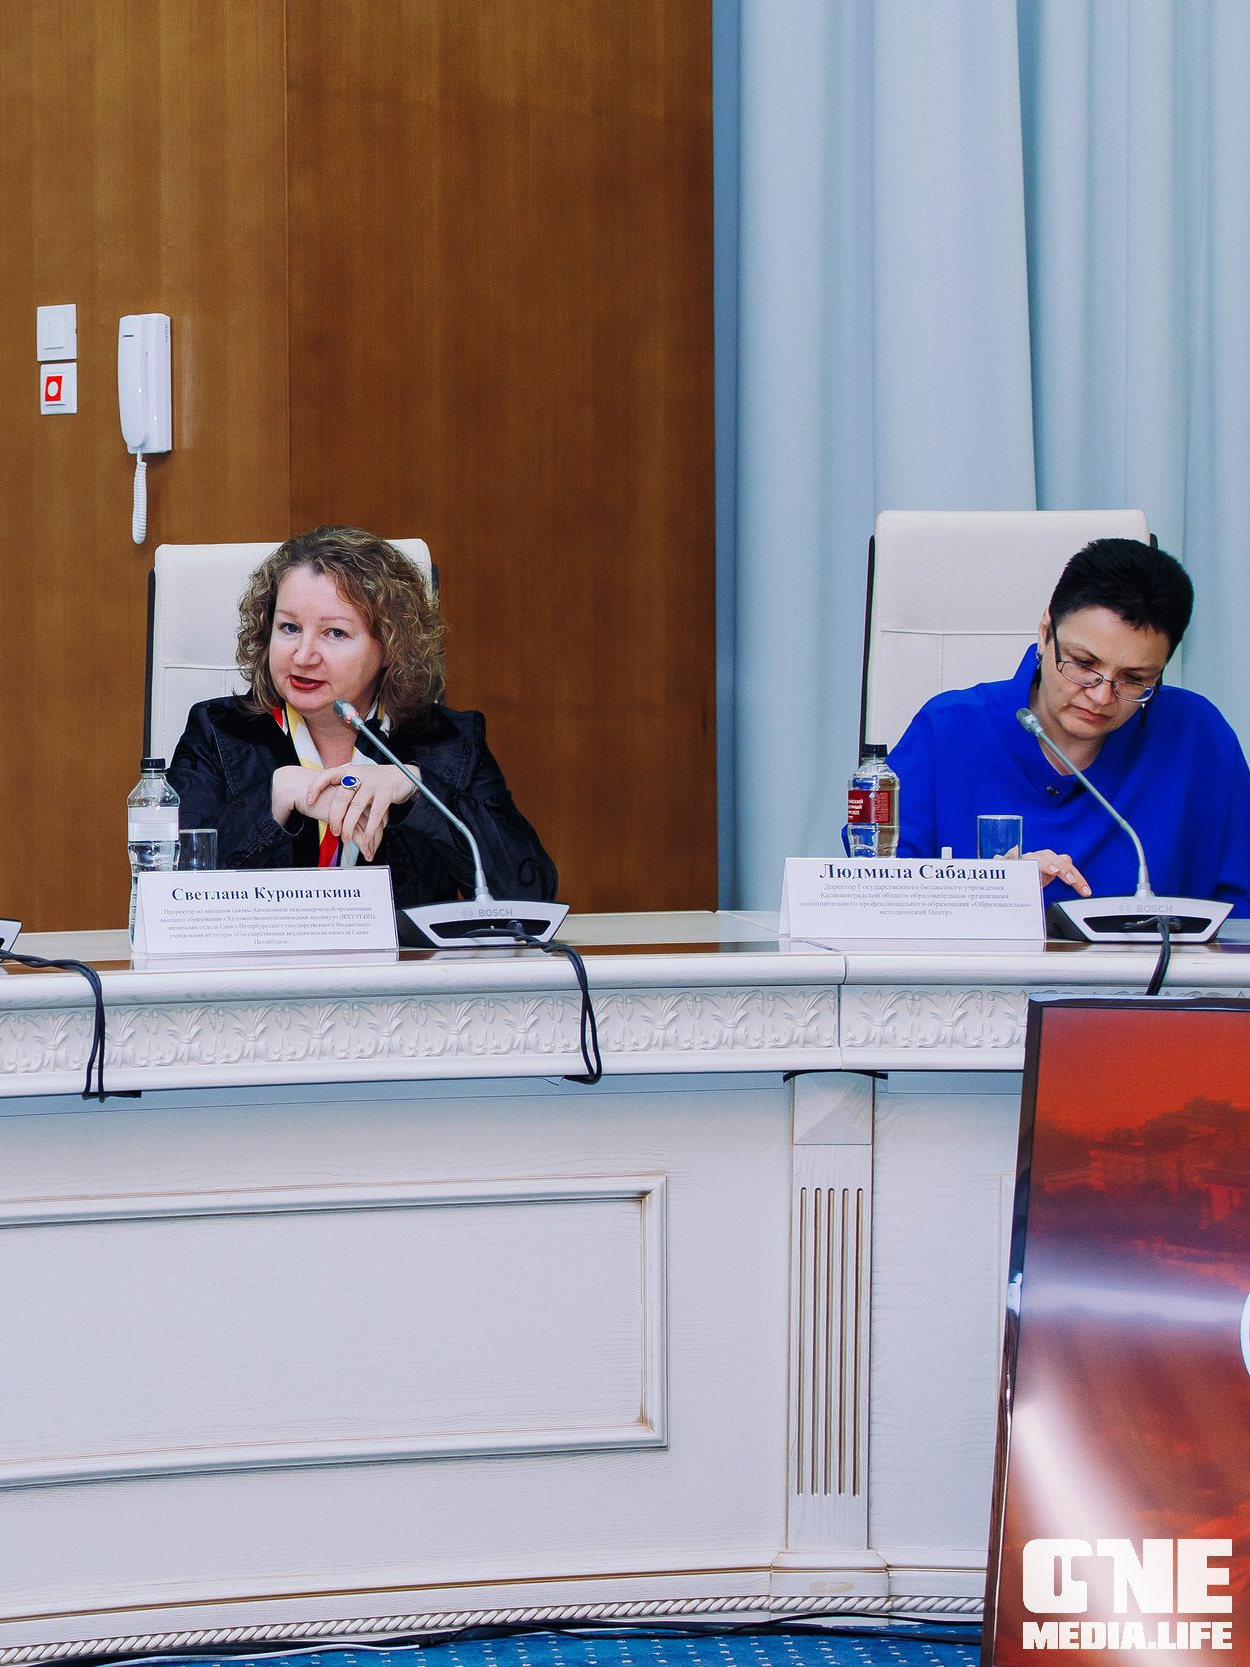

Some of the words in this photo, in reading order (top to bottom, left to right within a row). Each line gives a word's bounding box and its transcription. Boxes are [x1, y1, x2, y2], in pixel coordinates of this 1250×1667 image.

[819, 863, 912, 880] Людмила
[919, 864, 1006, 880] Сабадаш
[824, 883, 856, 891] Директор
[857, 883, 918, 891] Государственного
[171, 888, 248, 901] Светлана
[254, 887, 361, 902] Куропаткина
[910, 892, 966, 900] образовательная
[1136, 904, 1173, 912] BOSCH
[478, 908, 513, 917] BOSCH
